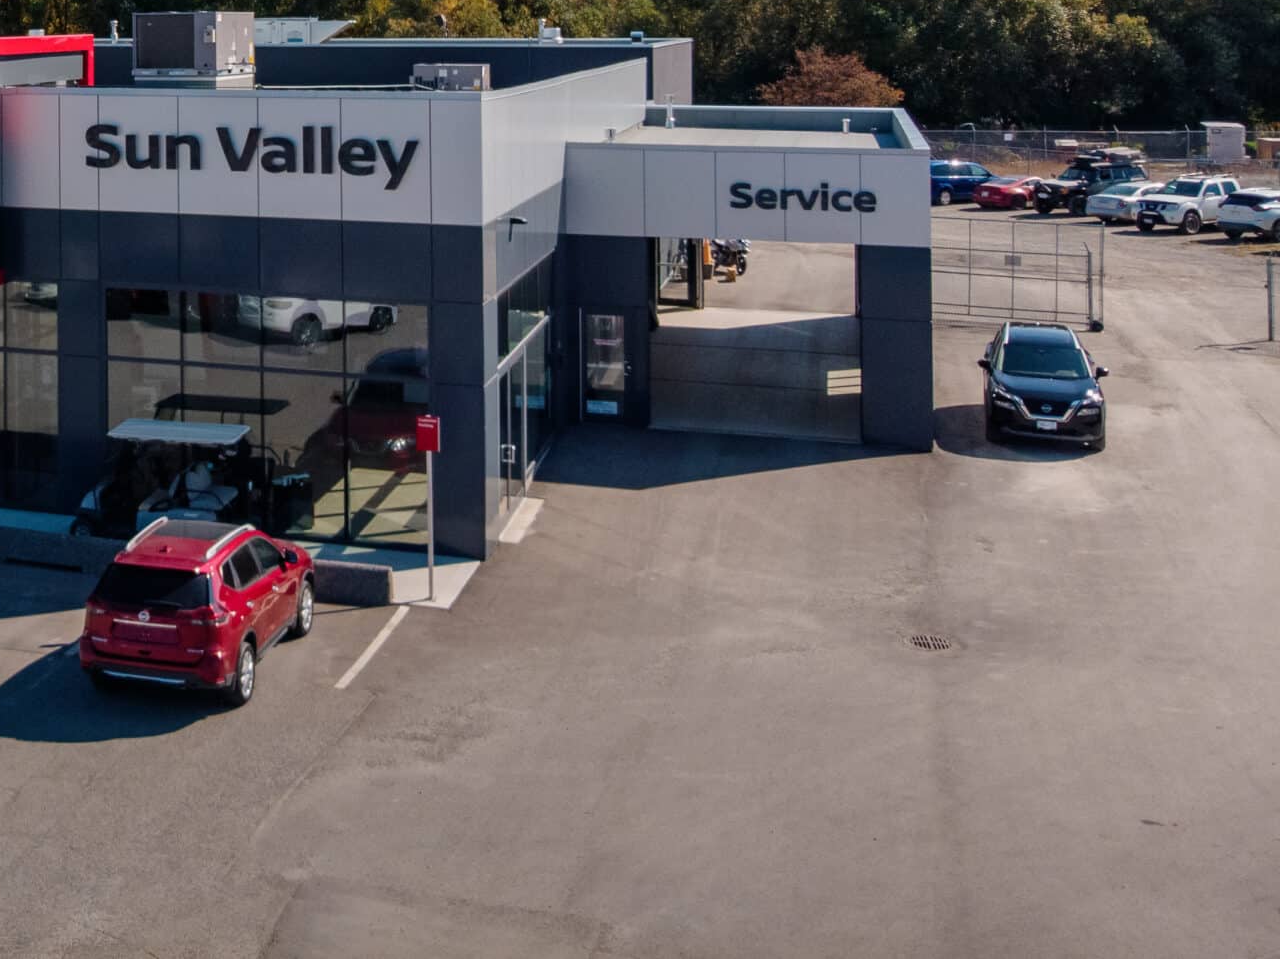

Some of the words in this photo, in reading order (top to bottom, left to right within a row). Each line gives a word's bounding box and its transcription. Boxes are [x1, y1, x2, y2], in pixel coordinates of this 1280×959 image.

[84, 123, 202, 171] Sun
[215, 125, 419, 191] Valley
[729, 181, 877, 213] Service
